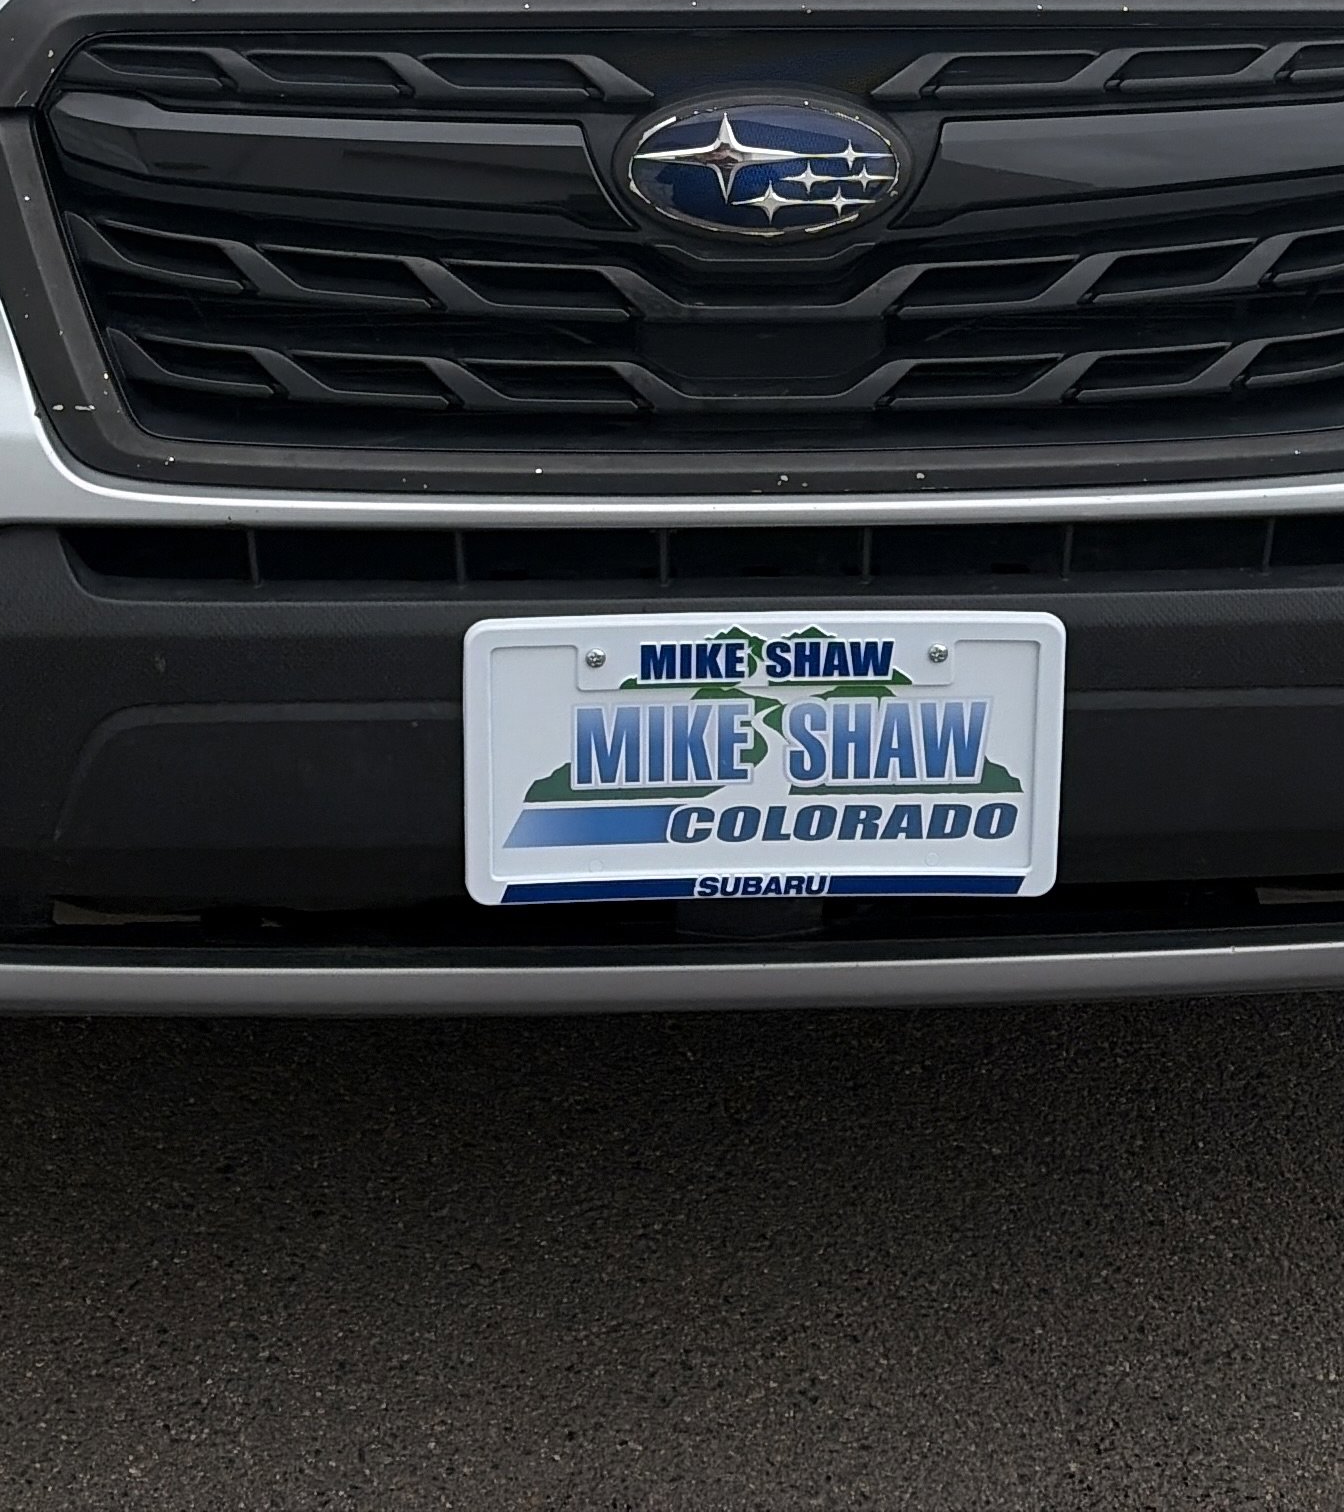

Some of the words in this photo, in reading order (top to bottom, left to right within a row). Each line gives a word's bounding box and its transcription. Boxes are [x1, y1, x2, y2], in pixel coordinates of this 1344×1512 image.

[640, 642, 746, 680] MIKE
[765, 640, 894, 678] SHAW
[575, 703, 753, 784] MIKE
[787, 699, 989, 782] SHAW
[668, 801, 1020, 844] COLORADO
[697, 874, 830, 898] SUBARU
